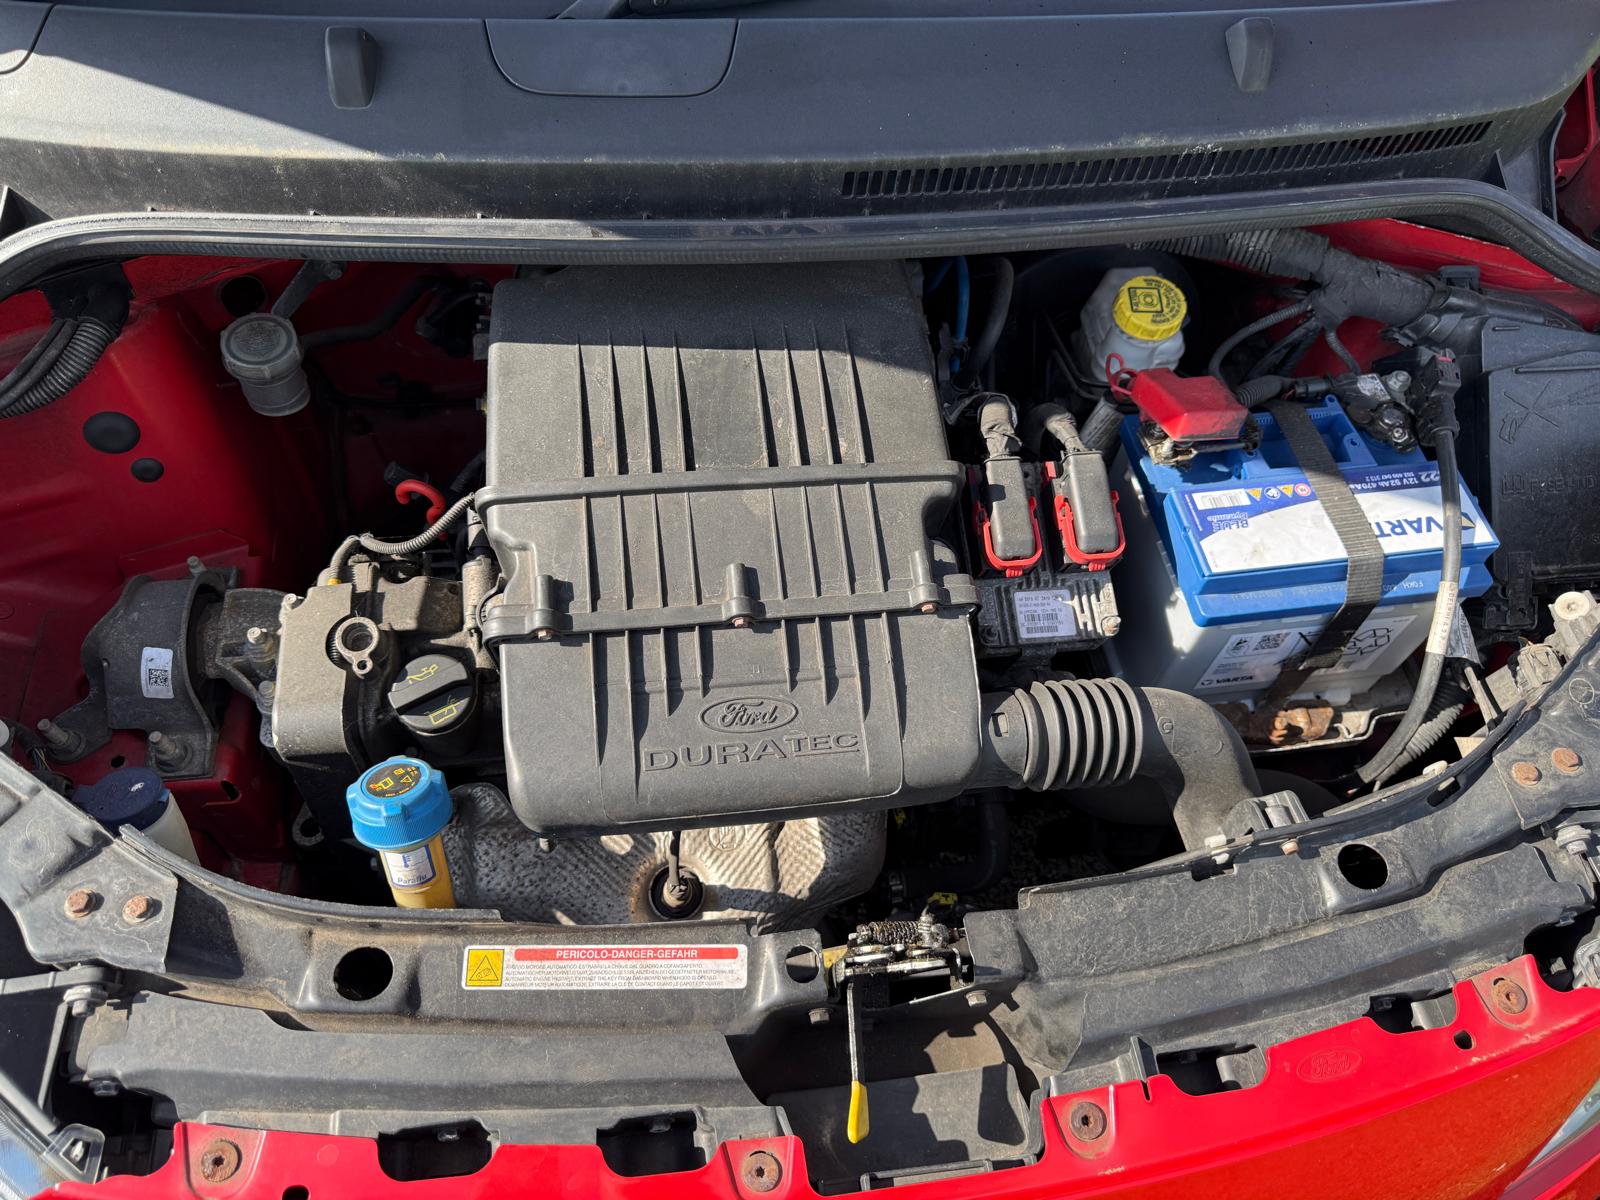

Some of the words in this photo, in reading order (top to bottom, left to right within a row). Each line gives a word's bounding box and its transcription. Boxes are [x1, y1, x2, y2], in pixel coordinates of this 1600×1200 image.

[1418, 470, 1440, 483] 22
[1212, 520, 1249, 532] BLUE
[1374, 516, 1443, 538] VART
[642, 732, 860, 772] DURATEC
[556, 949, 698, 959] PERICOLO-DANGER-GEFAHR
